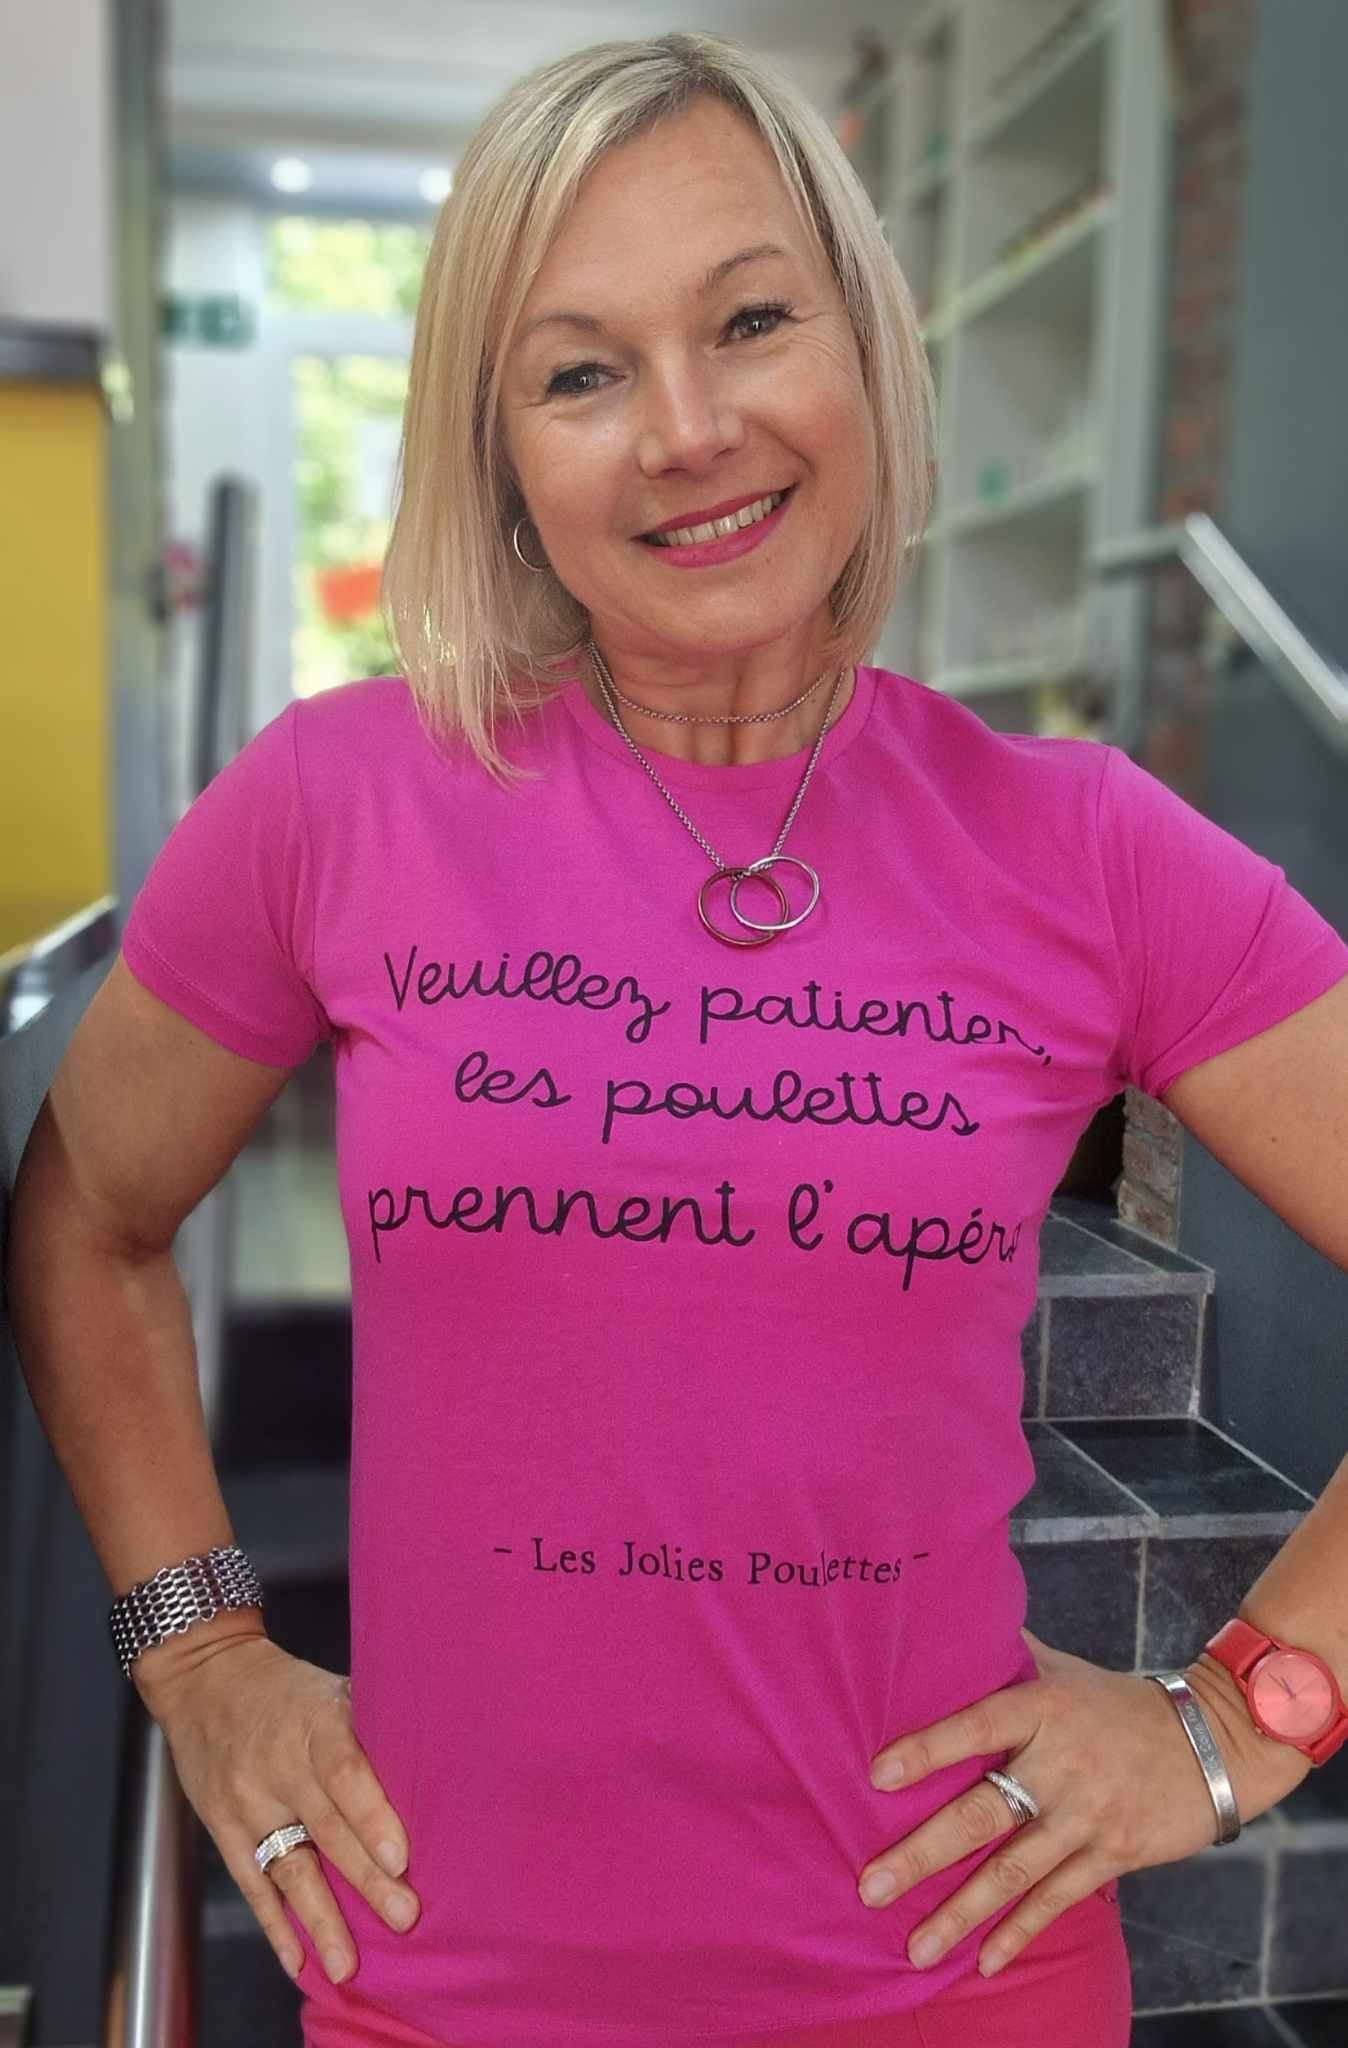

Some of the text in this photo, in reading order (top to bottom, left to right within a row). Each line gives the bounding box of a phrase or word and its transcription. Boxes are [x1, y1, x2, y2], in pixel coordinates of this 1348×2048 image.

[384, 945, 1052, 1066] Veuillez patienter,
[455, 1051, 980, 1144] les poulettes
[369, 1181, 756, 1263] prennent
[533, 1537, 596, 1574] Les
[619, 1542, 724, 1582] Jolies
[748, 1551, 901, 1587] Poulettes
